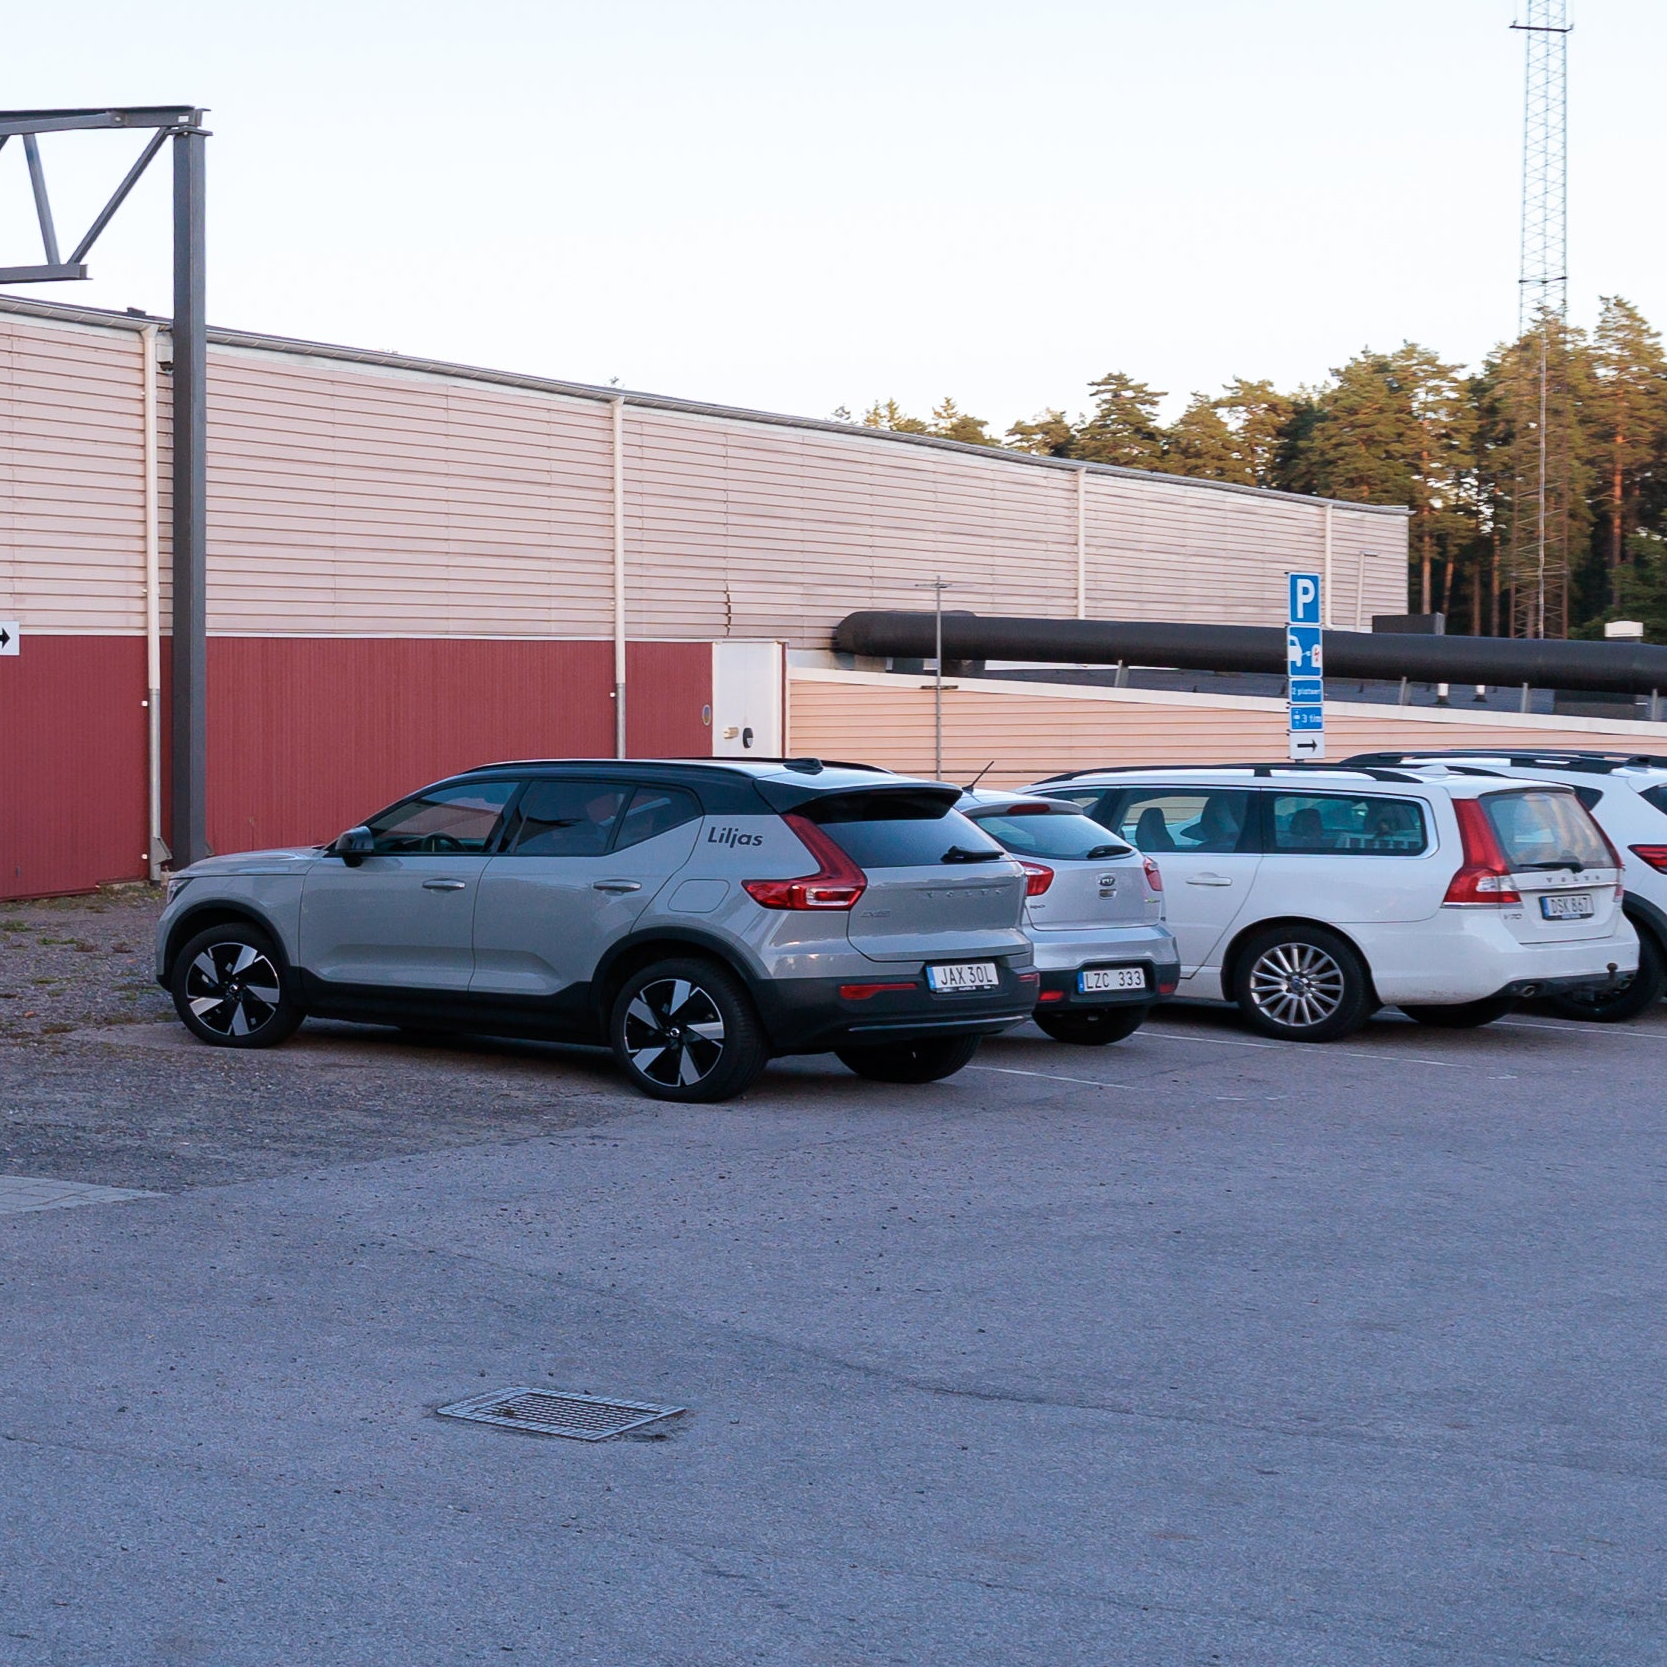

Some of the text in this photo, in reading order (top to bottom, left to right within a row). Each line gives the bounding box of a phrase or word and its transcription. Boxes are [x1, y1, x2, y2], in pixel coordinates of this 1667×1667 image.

[1296, 578, 1316, 619] P
[1302, 714, 1308, 723] 3
[707, 826, 763, 848] Liljas
[1546, 875, 1600, 883] VOLVO
[1551, 896, 1589, 914] DSK 867
[940, 965, 993, 985] JAX 30L
[1084, 970, 1143, 989] LZC 333
